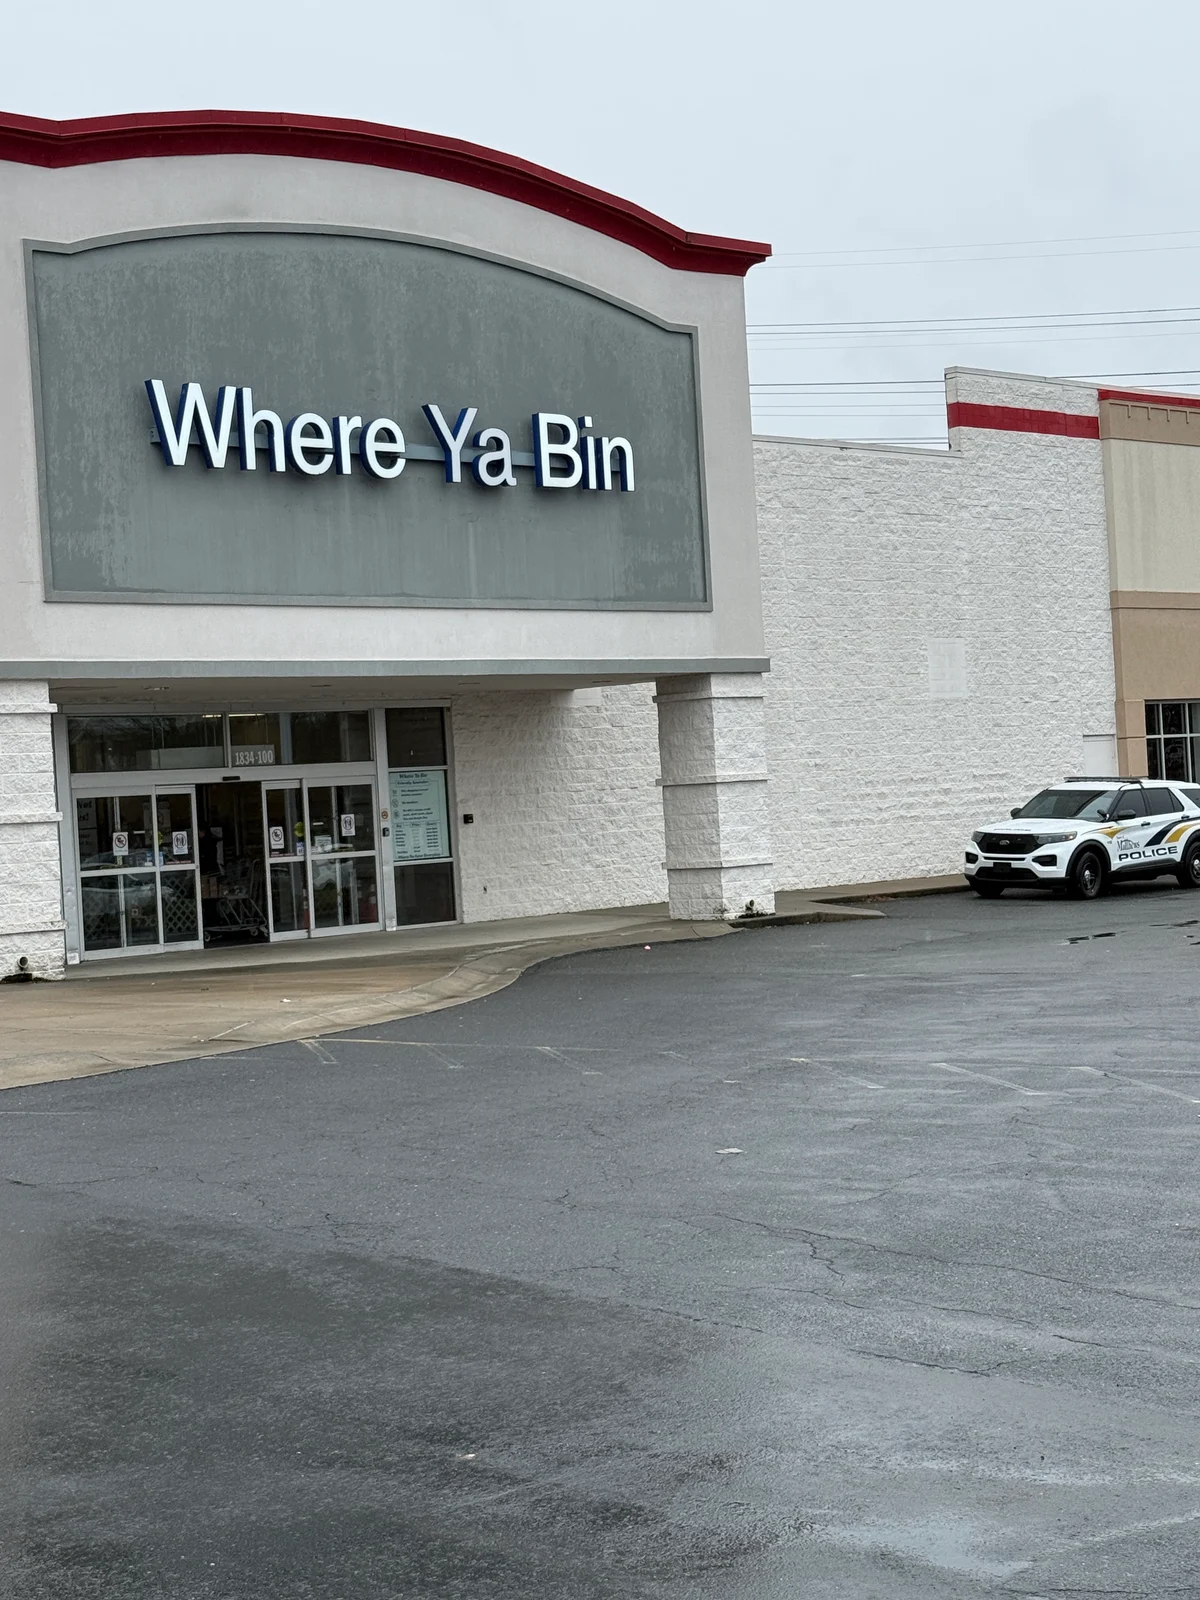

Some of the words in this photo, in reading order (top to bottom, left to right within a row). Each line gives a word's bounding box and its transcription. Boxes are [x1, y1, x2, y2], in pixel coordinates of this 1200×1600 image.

[145, 378, 406, 480] Where
[422, 403, 517, 488] Ya
[532, 412, 637, 493] Bin
[1118, 845, 1179, 862] POLICE
